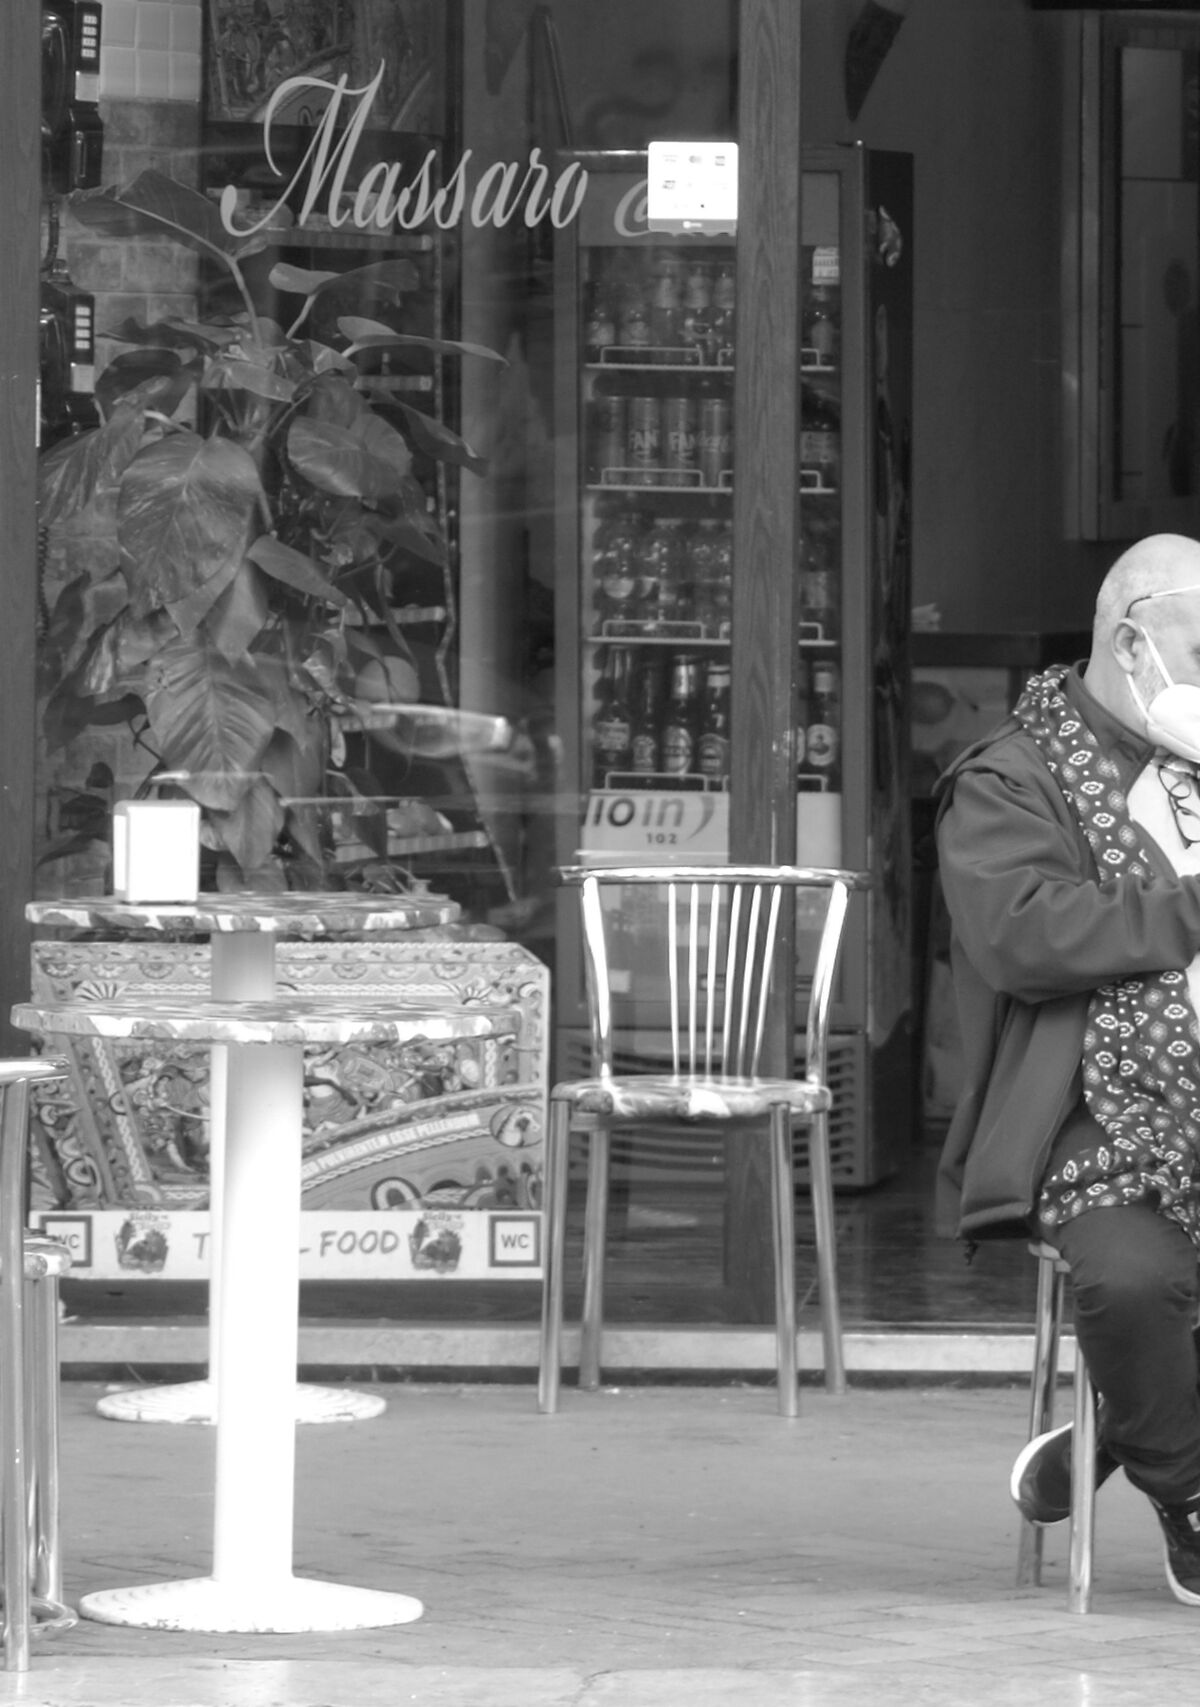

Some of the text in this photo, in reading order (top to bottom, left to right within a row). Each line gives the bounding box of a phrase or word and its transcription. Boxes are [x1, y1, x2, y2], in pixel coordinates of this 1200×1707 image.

[220, 58, 589, 237] Massaro
[646, 833, 677, 844] 102
[319, 1230, 400, 1257] FOOD
[501, 1233, 530, 1249] WC
